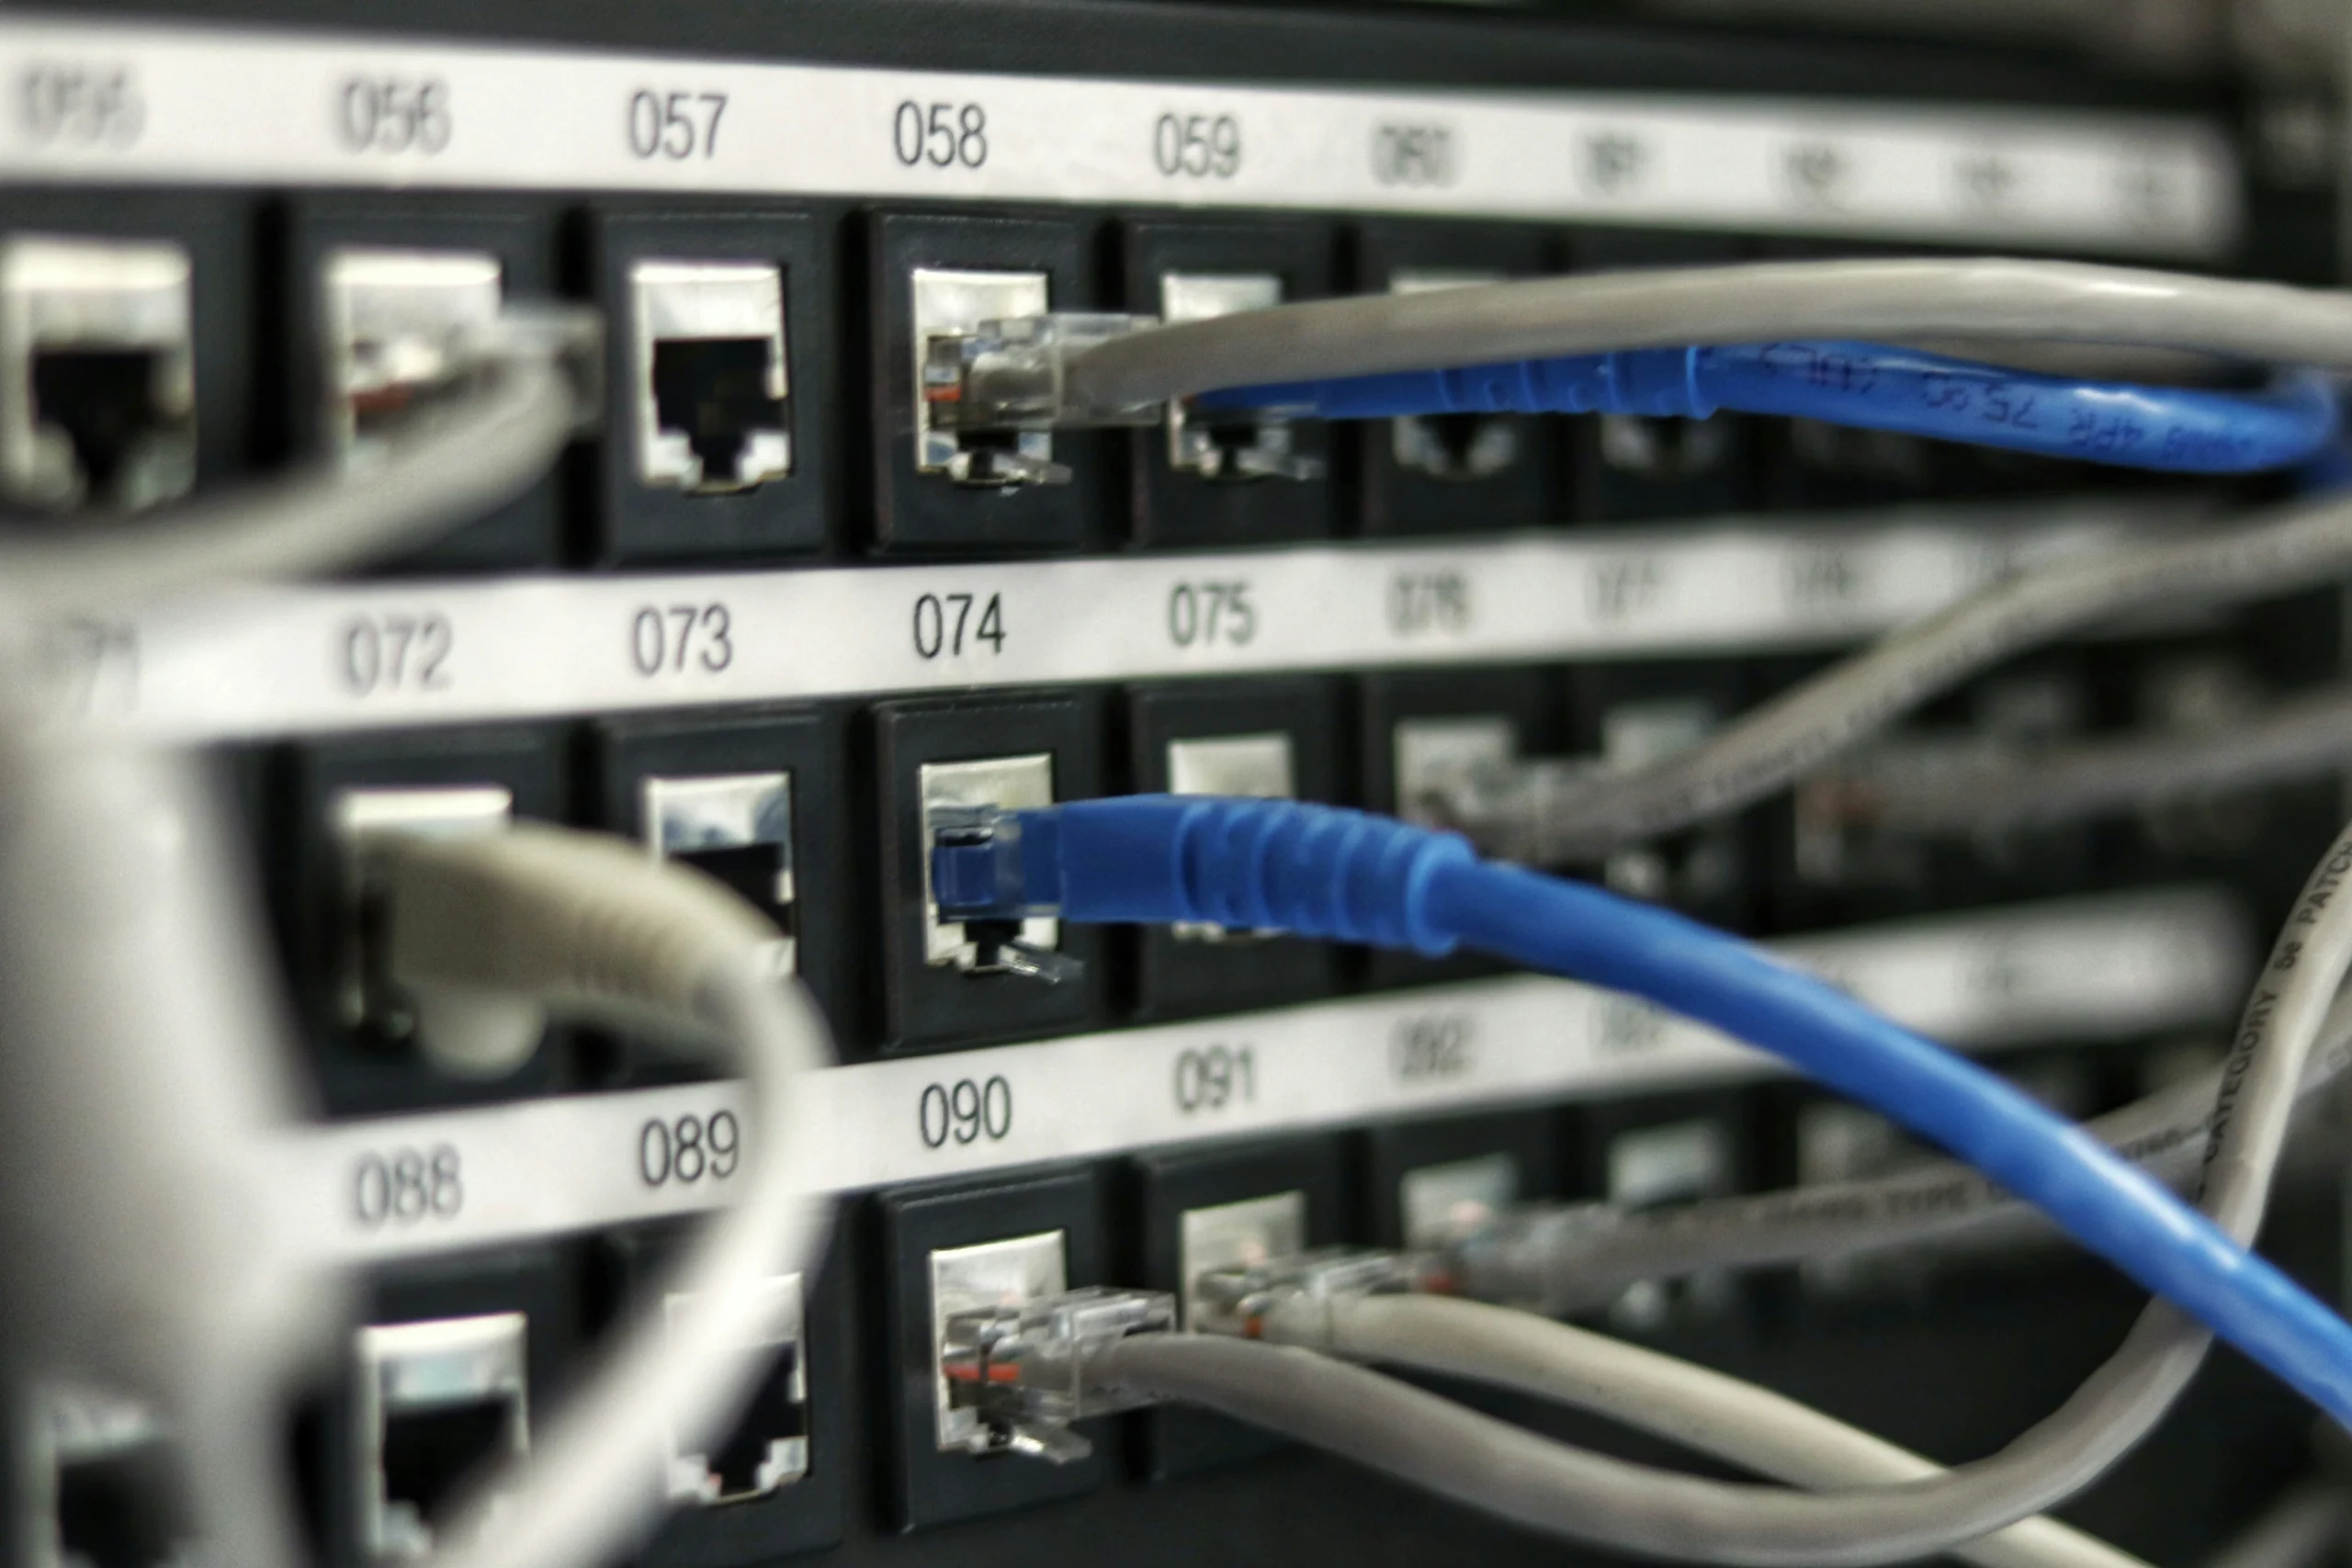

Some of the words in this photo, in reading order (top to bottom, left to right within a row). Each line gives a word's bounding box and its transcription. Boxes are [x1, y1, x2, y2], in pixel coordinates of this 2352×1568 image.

[340, 76, 453, 155] 056
[628, 88, 729, 159] 057
[893, 99, 989, 169] 058
[1154, 111, 1241, 179] 059
[342, 612, 455, 697] 072
[632, 603, 734, 677] 073
[912, 592, 1007, 659] 074
[1167, 580, 1256, 648] 075
[354, 1142, 463, 1226] 088
[638, 1108, 738, 1187] 089
[920, 1074, 1013, 1150] 090
[1173, 1043, 1255, 1114] 091
